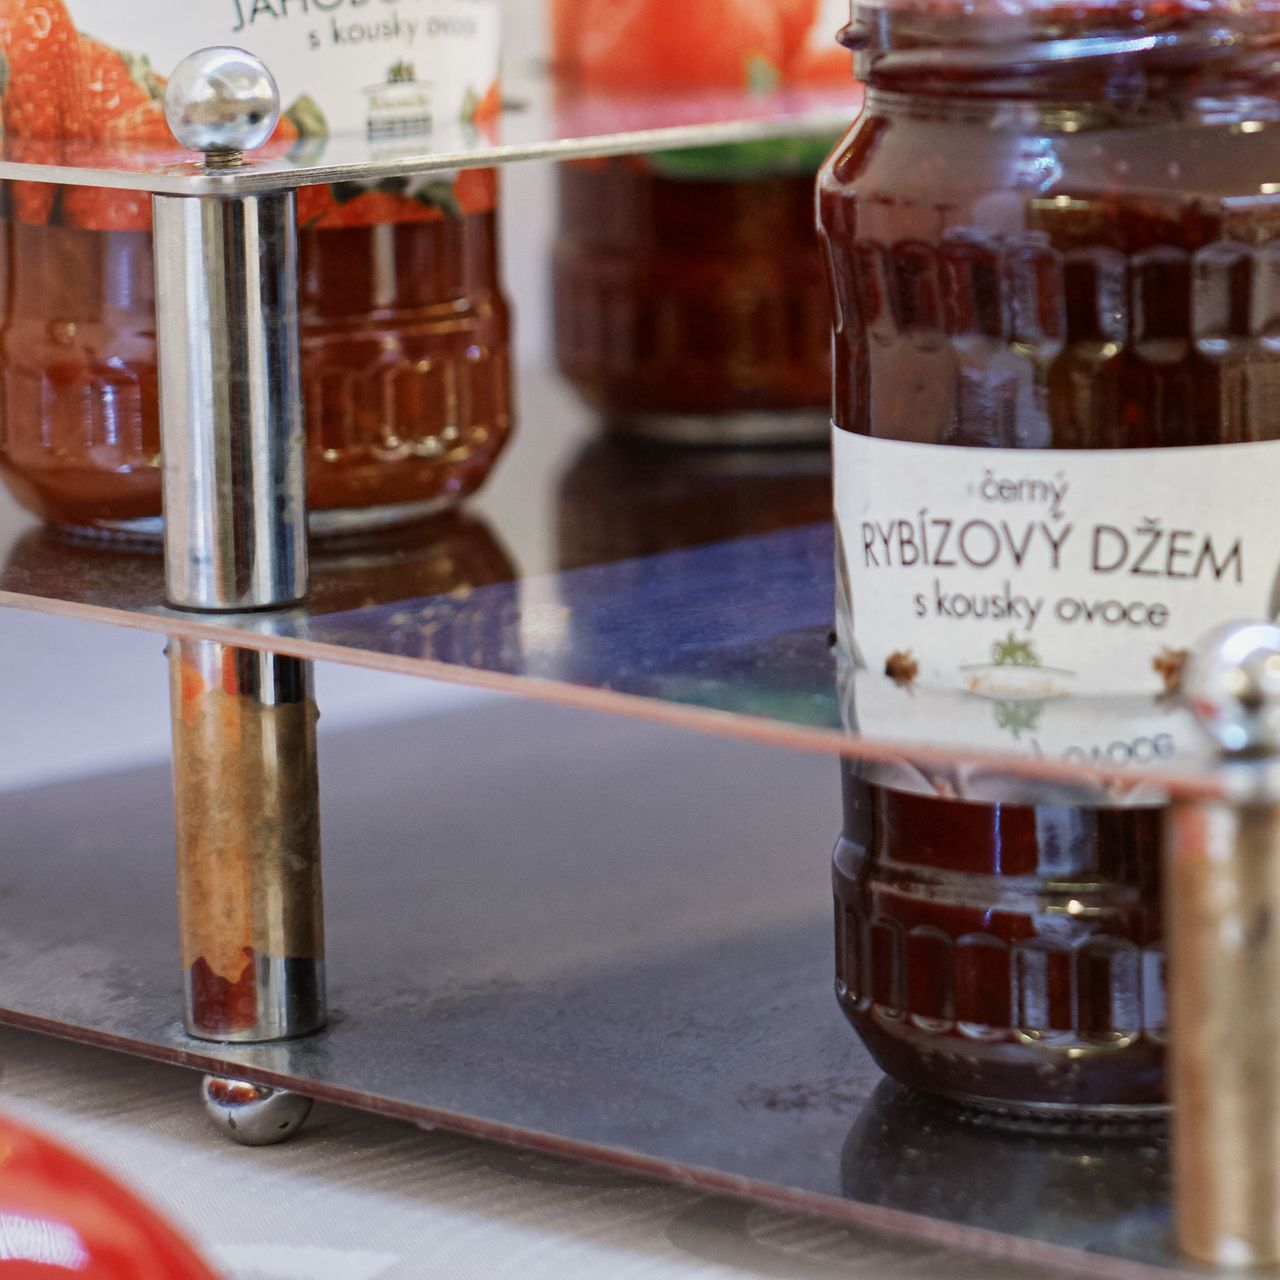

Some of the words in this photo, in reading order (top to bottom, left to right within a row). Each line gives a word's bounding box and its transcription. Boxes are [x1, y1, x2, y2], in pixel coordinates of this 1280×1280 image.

[308, 27, 322, 50] s
[333, 9, 419, 47] kousky
[980, 469, 1068, 509] černý
[861, 507, 1072, 572] RYBÍZOVÝ
[1091, 517, 1245, 584] DŽEM
[914, 591, 928, 618] s
[934, 578, 1044, 631] kousky
[1054, 596, 1170, 628] ovoce
